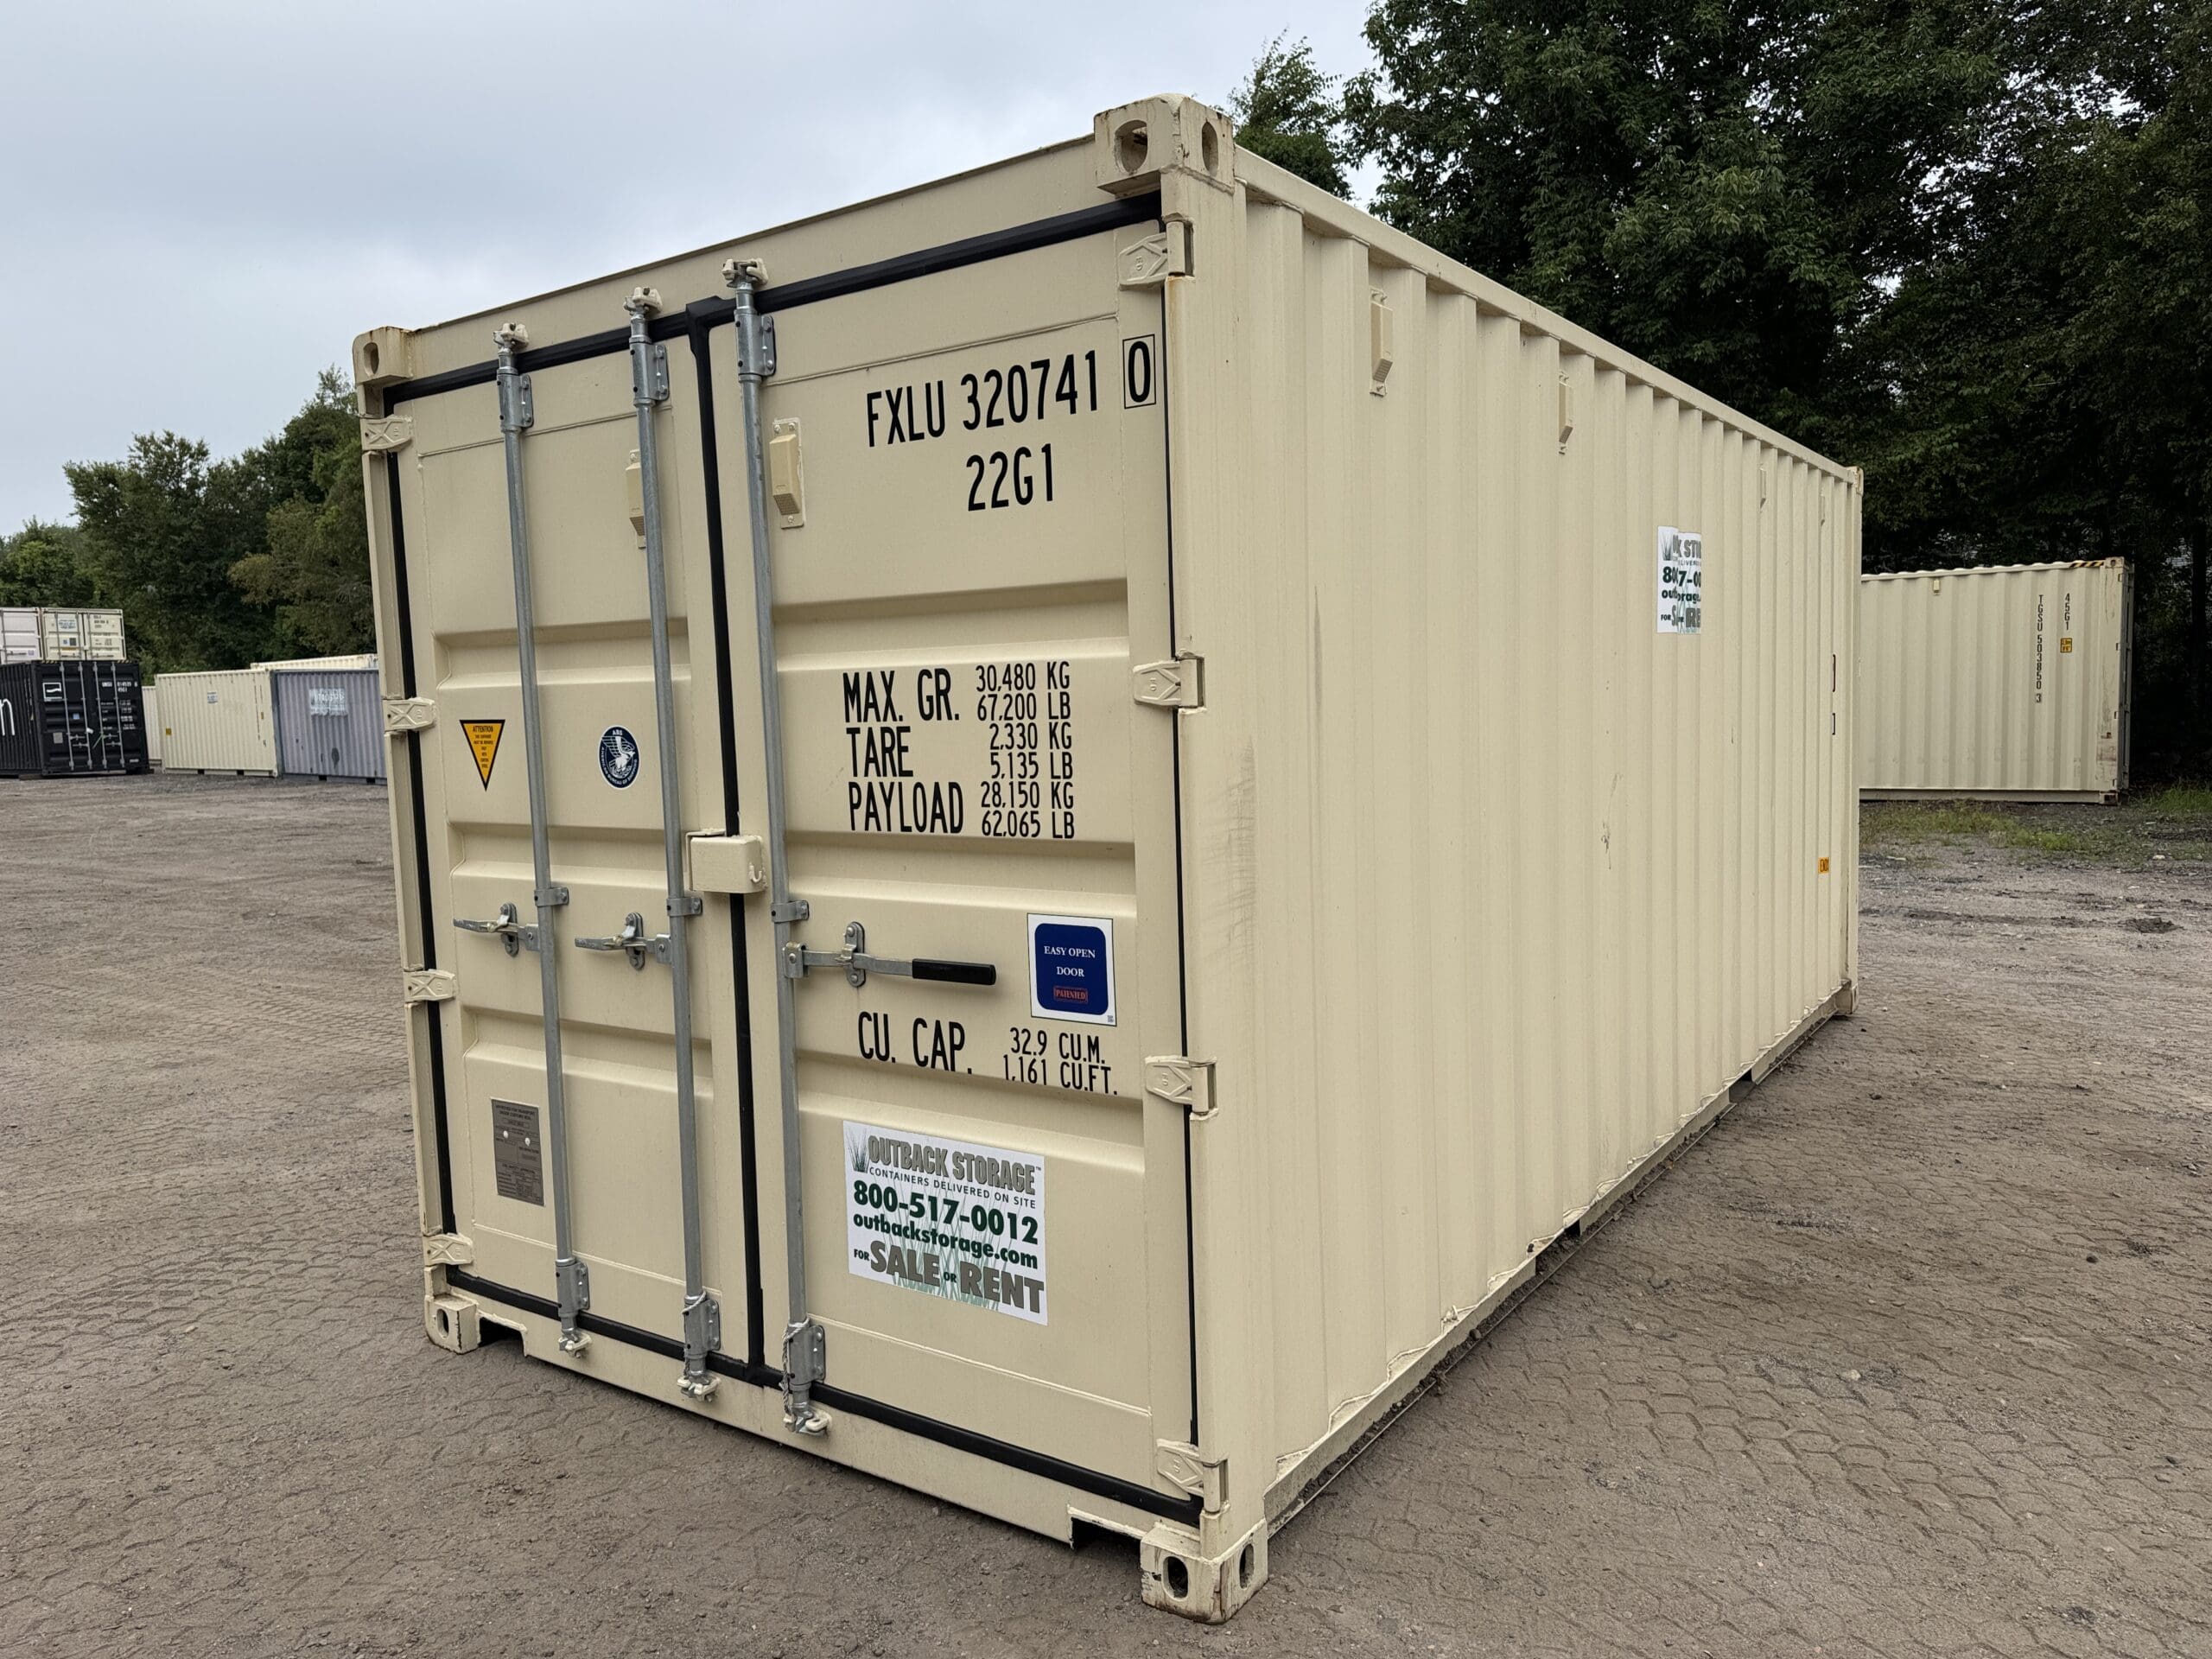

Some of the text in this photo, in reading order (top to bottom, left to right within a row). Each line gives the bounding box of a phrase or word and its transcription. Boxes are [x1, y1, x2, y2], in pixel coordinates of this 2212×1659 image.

[867, 340, 1151, 448] FXLU 320741 0
[966, 442, 1053, 512] 22G1
[842, 661, 1071, 722] MAX. GR. 30,480 KG
[977, 691, 1071, 721] 67,200 LB
[2036, 693, 2042, 703] 3
[846, 721, 1072, 778] TARE 2,330 KG
[990, 751, 1073, 779] 5,135 LB
[849, 781, 1074, 834] PAYLOAD 28,150 KG
[982, 810, 1075, 839] 62,065 LB
[1044, 945, 1096, 958] EASY OPEN
[1056, 966, 1084, 977] DOOR
[1055, 989, 1086, 1000] PATENTED
[858, 1011, 1106, 1074] CU. CAP. 32.9 CU.M.
[1003, 1054, 1047, 1085] 1,161
[868, 1135, 1036, 1195] OUTBACK STORAGE
[869, 1166, 1036, 1209] CONTAINERS DELIVERED ON SITE
[854, 1179, 1038, 1244] 800-517-0012
[853, 1212, 1038, 1269] outbackstorage.com
[854, 1240, 1045, 1314] FOR SALE OR RENT
